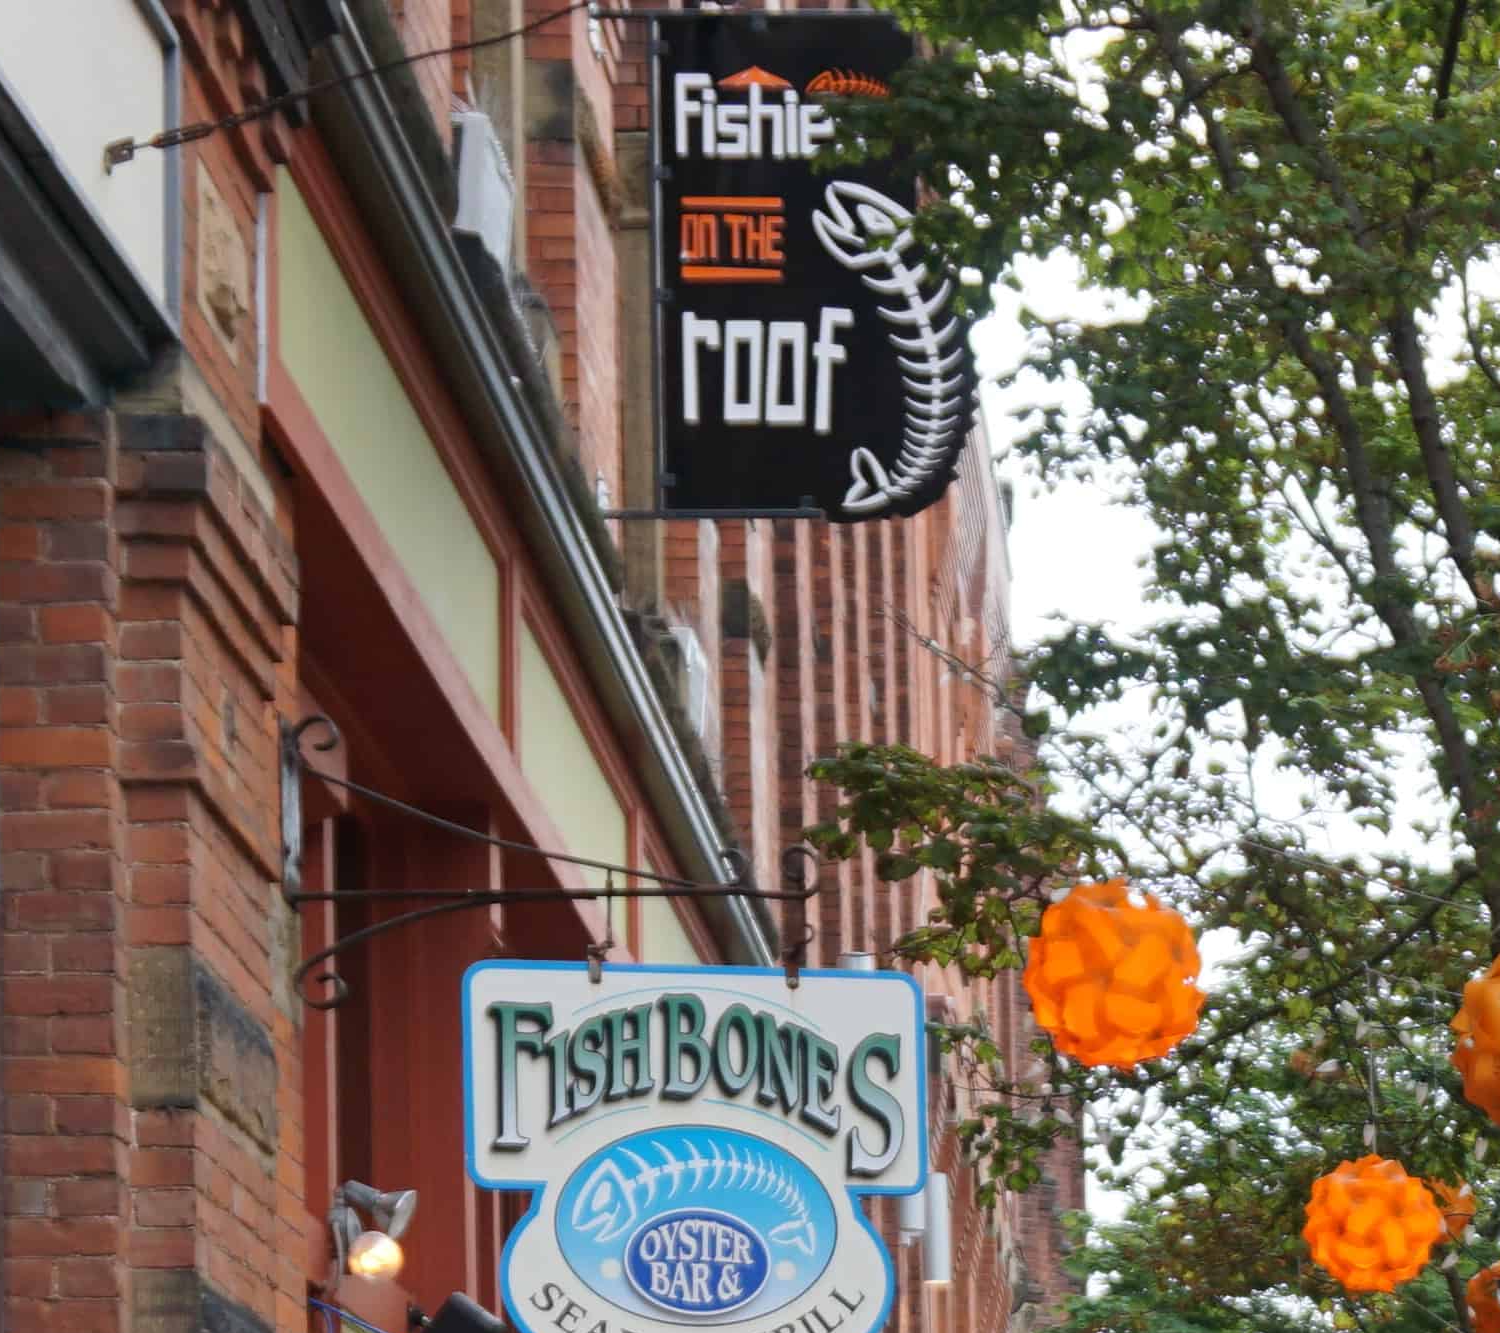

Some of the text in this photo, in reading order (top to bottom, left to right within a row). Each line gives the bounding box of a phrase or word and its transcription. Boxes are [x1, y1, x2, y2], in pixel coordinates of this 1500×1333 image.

[724, 214, 785, 261] THE
[682, 307, 854, 435] roof
[639, 1217, 755, 1266] OYSTER
[650, 1262, 743, 1303] BAR &
